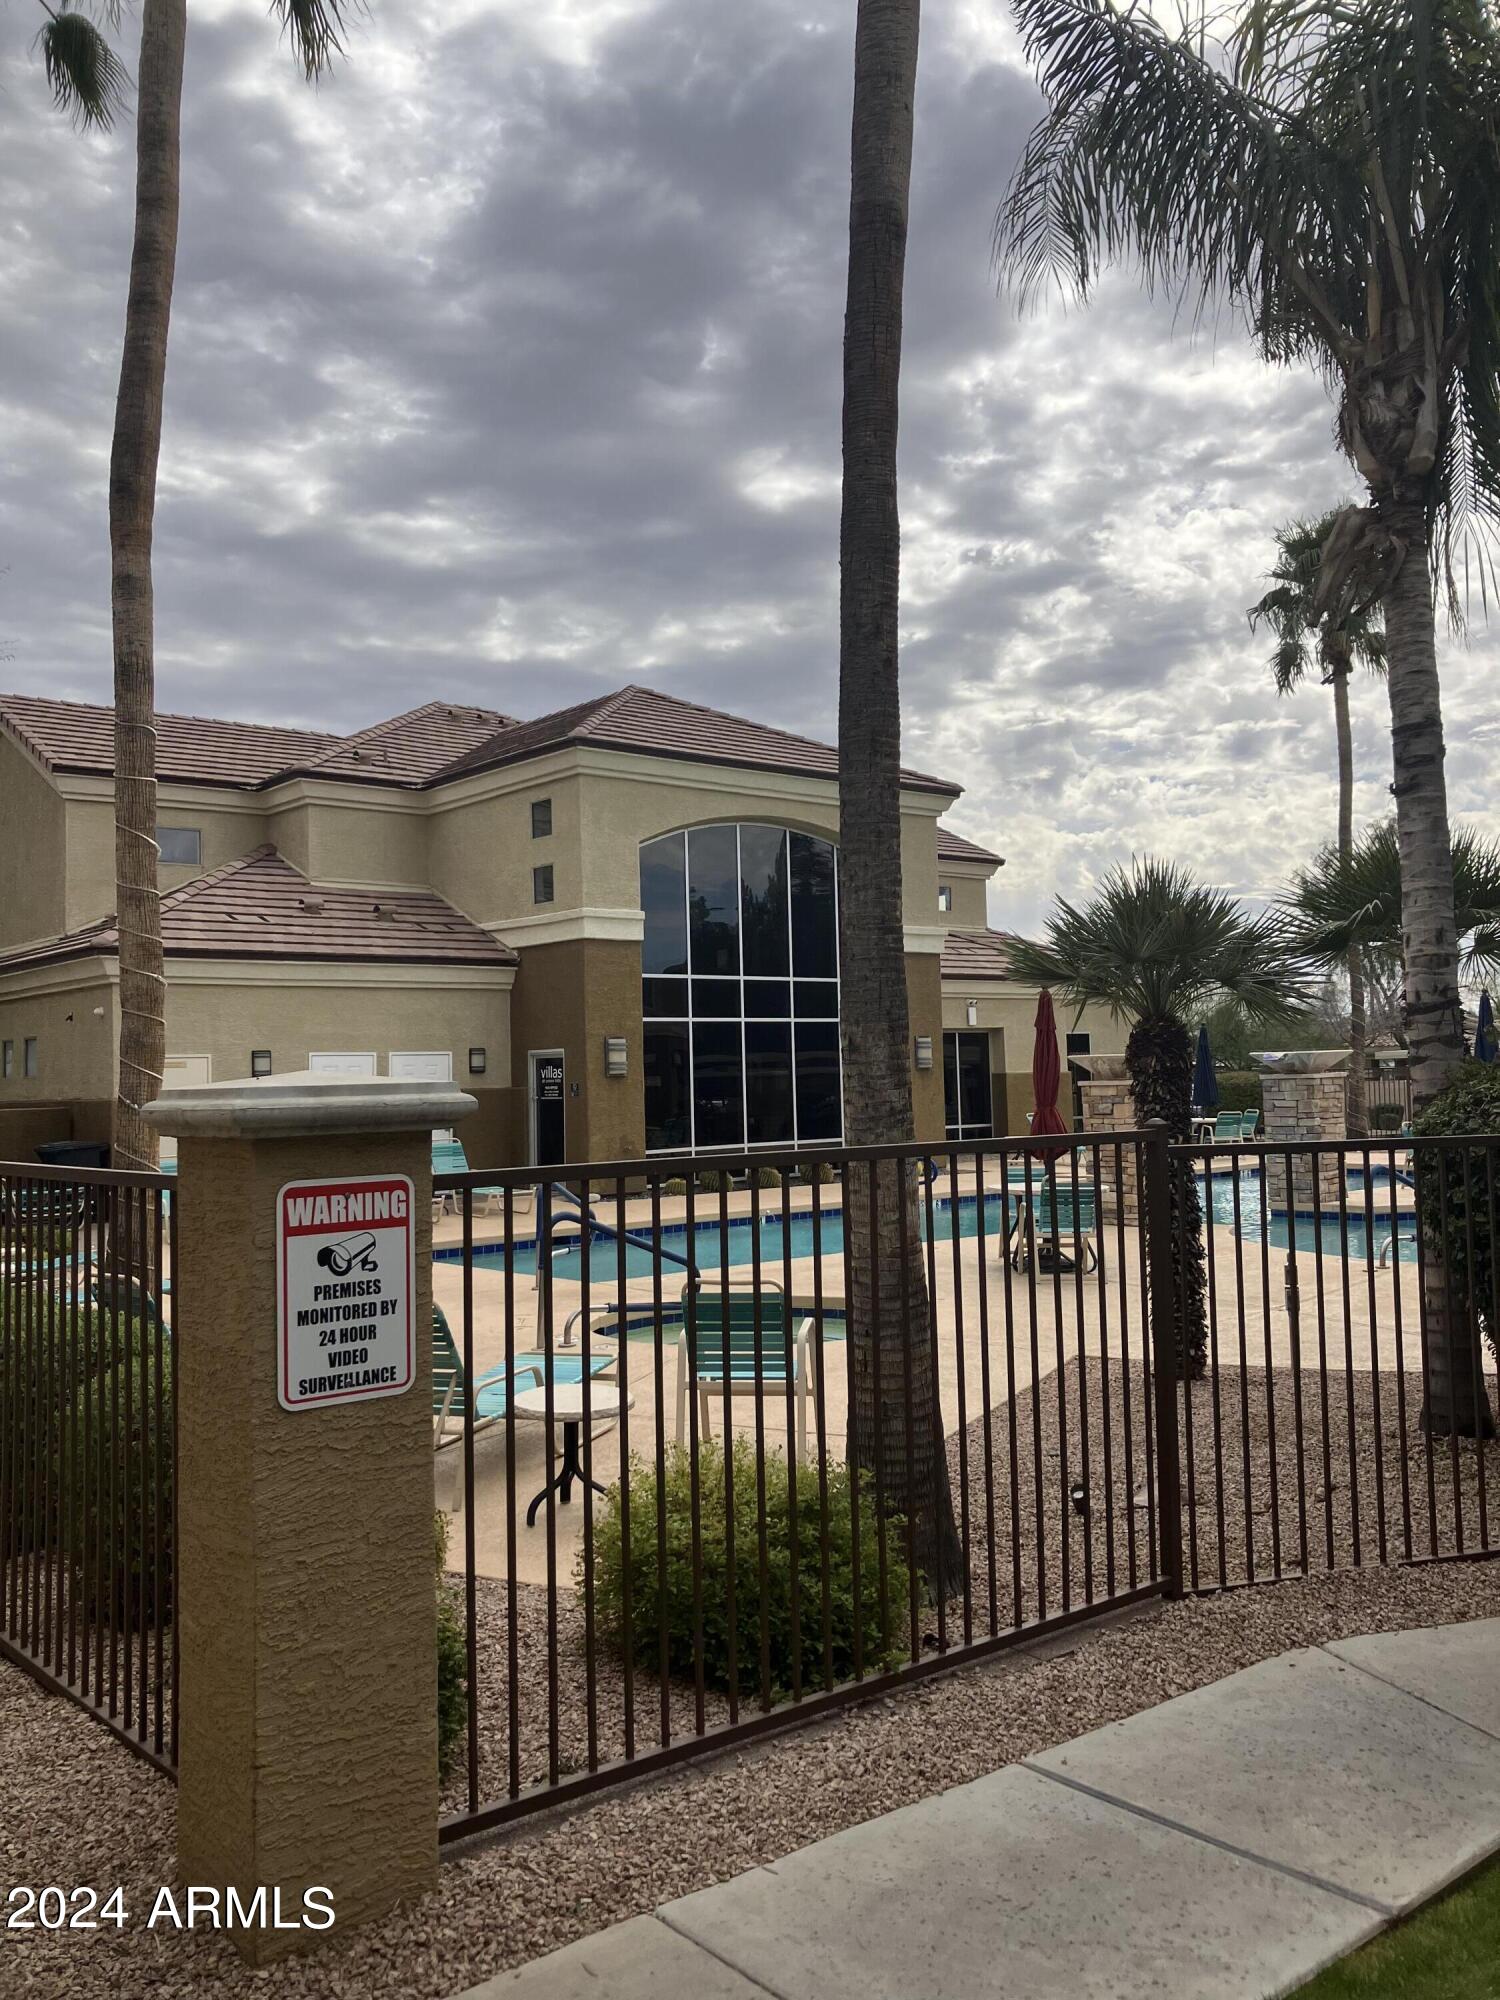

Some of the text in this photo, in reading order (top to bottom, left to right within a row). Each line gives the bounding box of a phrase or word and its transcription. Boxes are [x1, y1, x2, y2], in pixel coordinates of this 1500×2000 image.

[541, 1065, 562, 1079] villas
[286, 1190, 407, 1227] WARNING
[314, 1279, 382, 1302] PREMISES
[297, 1299, 398, 1327] MONITORED BY
[319, 1324, 377, 1347] 24 HOUR
[328, 1347, 369, 1368] VIDEO
[299, 1365, 397, 1396] SURVEILLANCE
